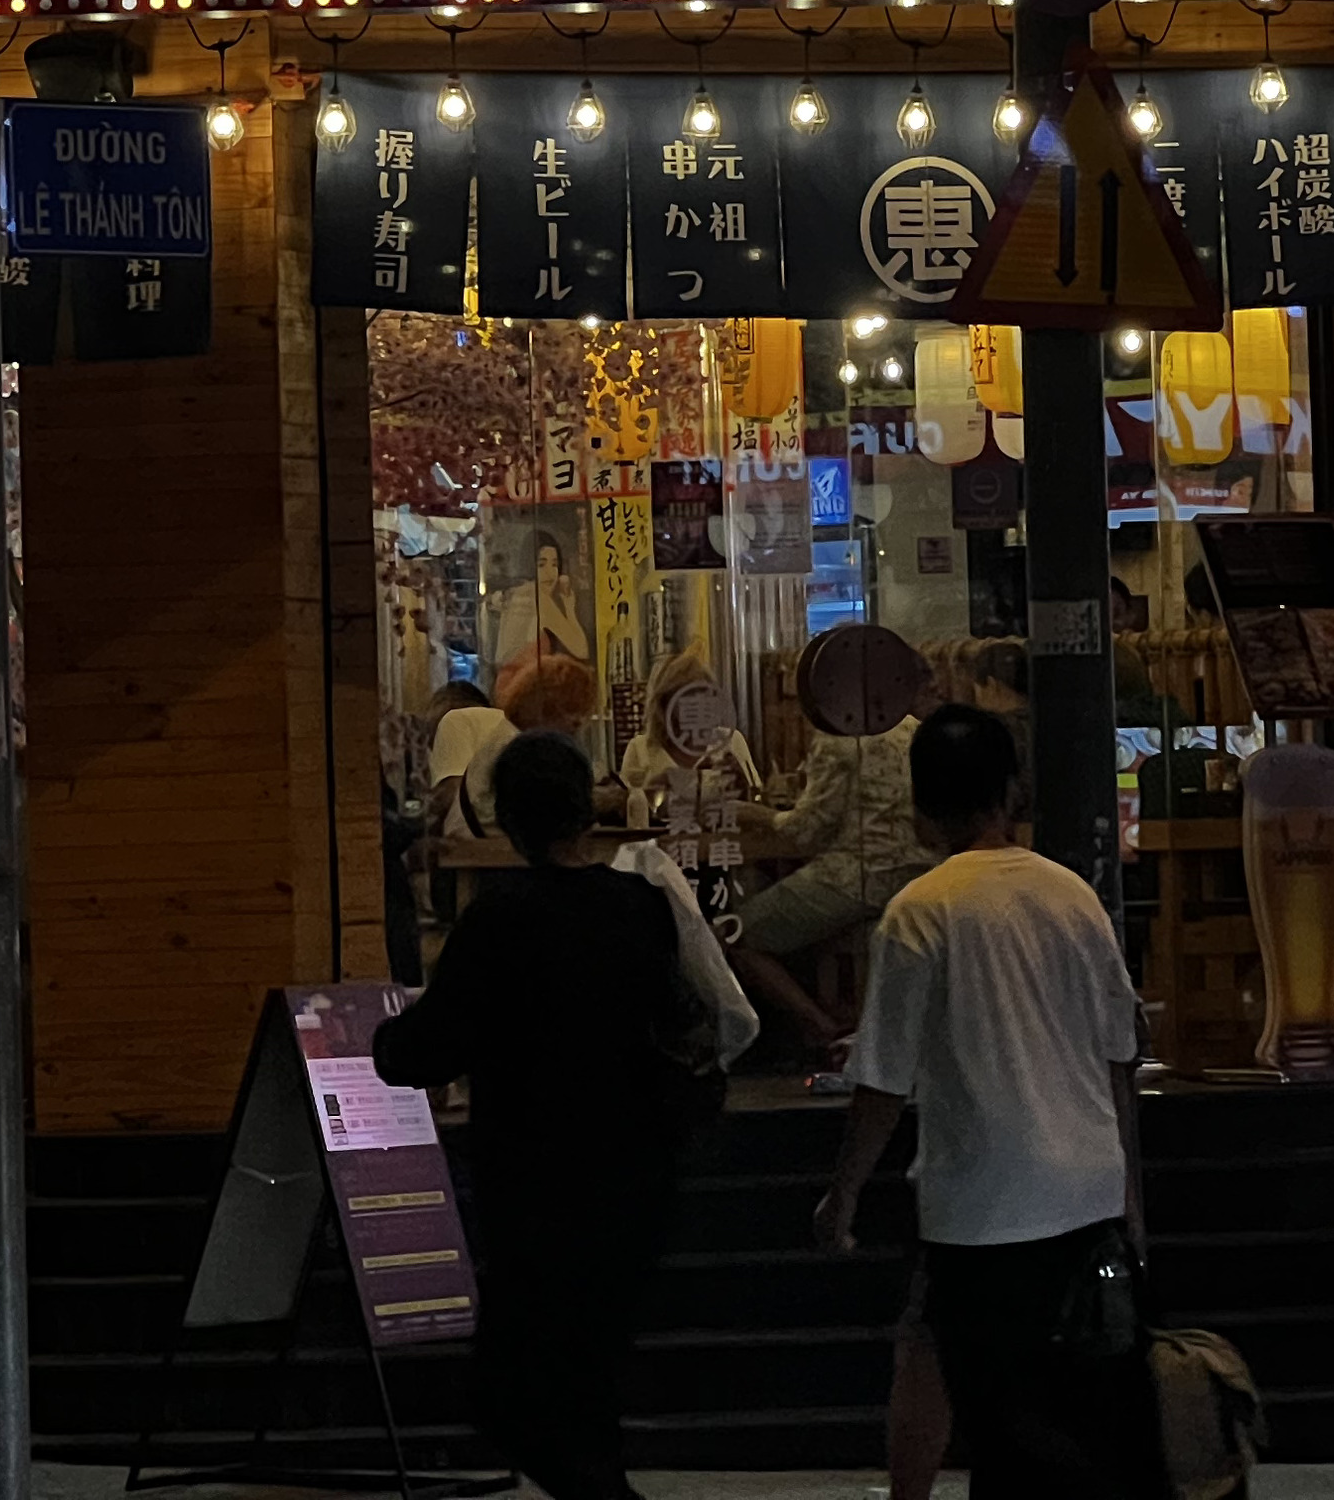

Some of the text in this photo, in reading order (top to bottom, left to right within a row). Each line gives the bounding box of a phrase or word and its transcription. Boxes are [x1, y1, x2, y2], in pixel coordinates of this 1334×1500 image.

[19, 176, 204, 241] LÊ THÁNH TÔN
[54, 121, 167, 164] ĐƯỜNG
[374, 129, 415, 293] 握り寿司
[533, 138, 573, 300] 生ビール
[662, 140, 704, 302] 串かつ
[707, 143, 748, 242] 元祖
[1252, 137, 1297, 297] ハイボール
